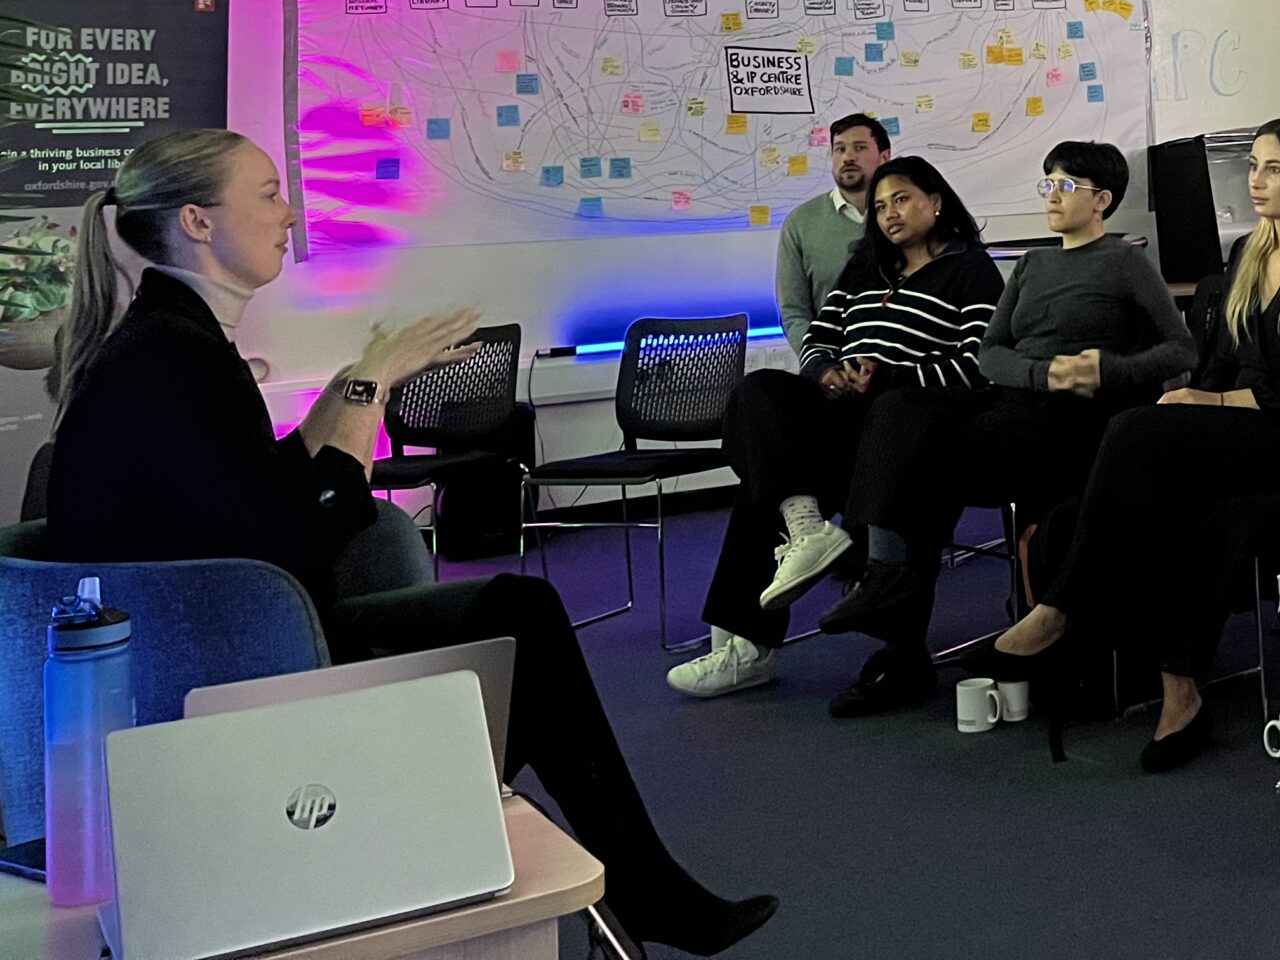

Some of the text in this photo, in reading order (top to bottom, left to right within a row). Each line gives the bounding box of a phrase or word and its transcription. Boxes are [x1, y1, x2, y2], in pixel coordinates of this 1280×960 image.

[26, 26, 156, 51] FOR EVERY
[730, 53, 801, 71] BUSINESS
[107, 63, 169, 86] IDEA,
[731, 70, 801, 85] & IP CENTRE
[733, 86, 804, 96] OXFORDSHIRE
[10, 97, 170, 120] EVERYWHERE
[30, 147, 73, 160] thriving
[76, 147, 121, 157] business
[38, 161, 49, 171] in
[52, 161, 76, 173] your
[80, 159, 104, 170] local
[293, 785, 330, 829] hp
